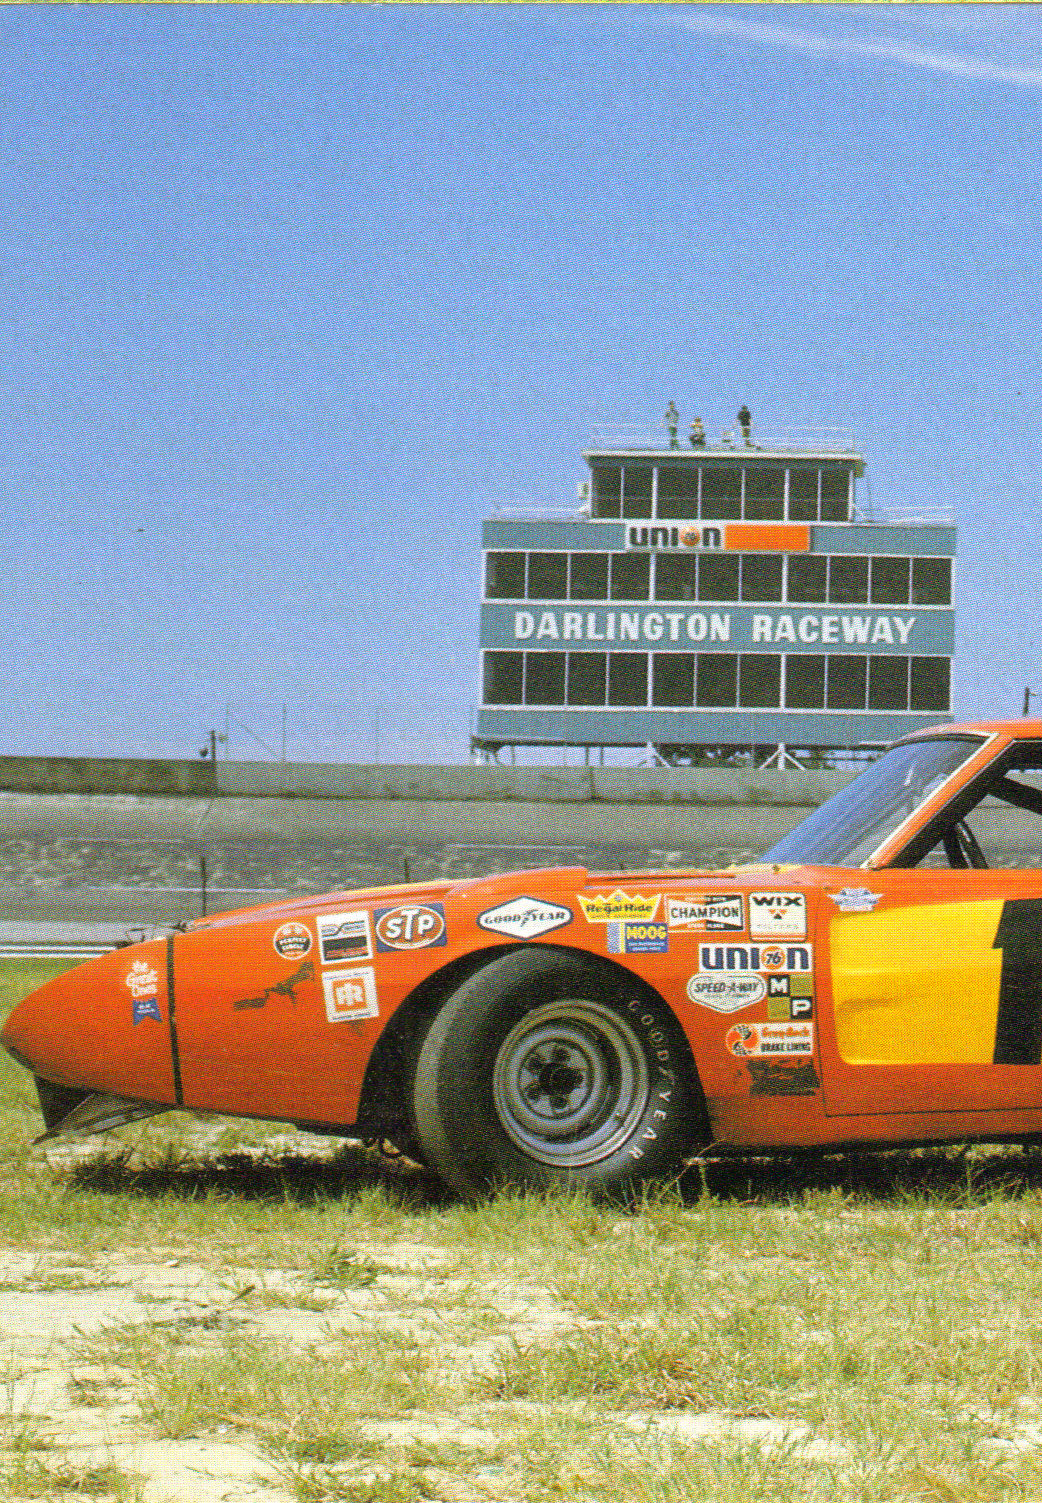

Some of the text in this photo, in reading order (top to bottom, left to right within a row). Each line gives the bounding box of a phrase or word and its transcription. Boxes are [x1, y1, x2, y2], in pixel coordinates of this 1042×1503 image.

[513, 610, 917, 645] DARLINGTON RACEWAY
[585, 902, 653, 916] Regal Ride
[752, 896, 803, 907] WIX
[670, 906, 740, 919] CHAMPION
[385, 908, 435, 941] STP
[625, 925, 667, 940] MOOG
[769, 977, 789, 995] M
[791, 999, 812, 1016] P
